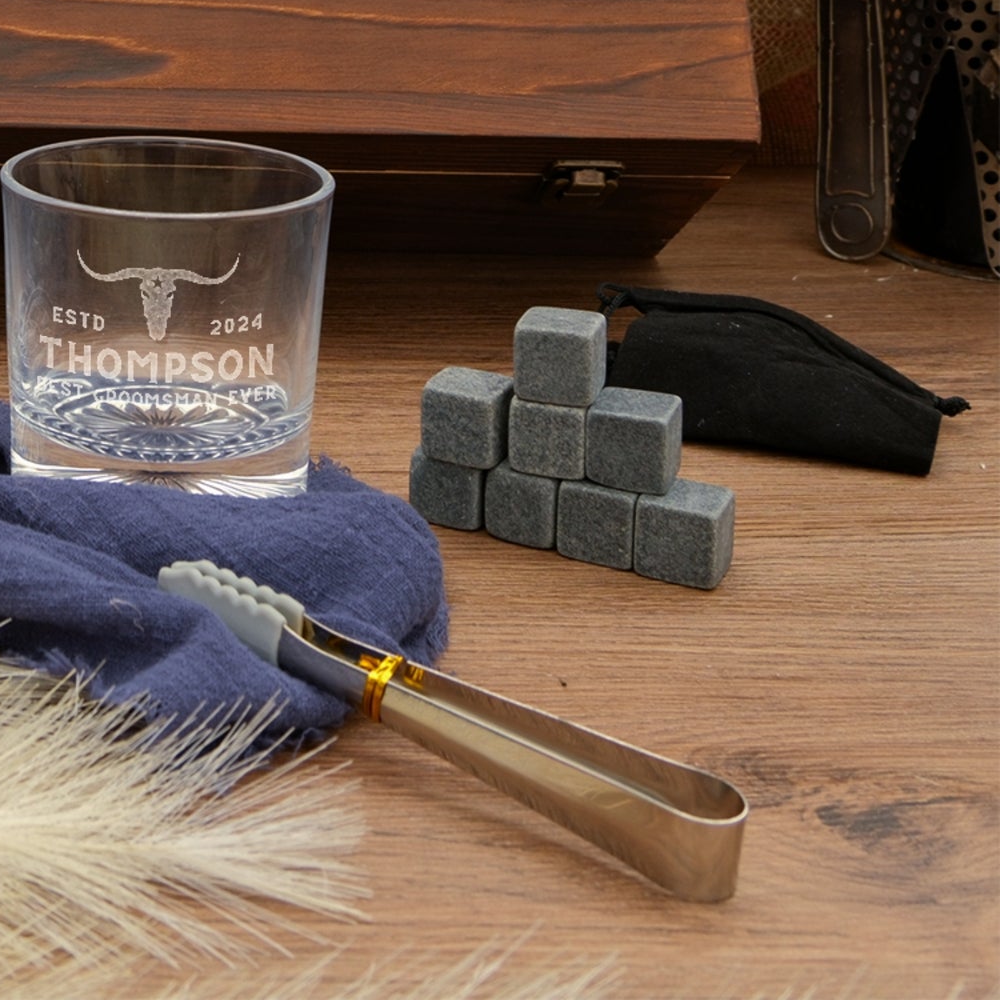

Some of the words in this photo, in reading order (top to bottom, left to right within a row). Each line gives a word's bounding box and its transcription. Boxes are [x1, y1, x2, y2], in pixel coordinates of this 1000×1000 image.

[53, 306, 104, 331] ESTD
[210, 313, 262, 335] 2024
[40, 334, 275, 384] THOMPSON
